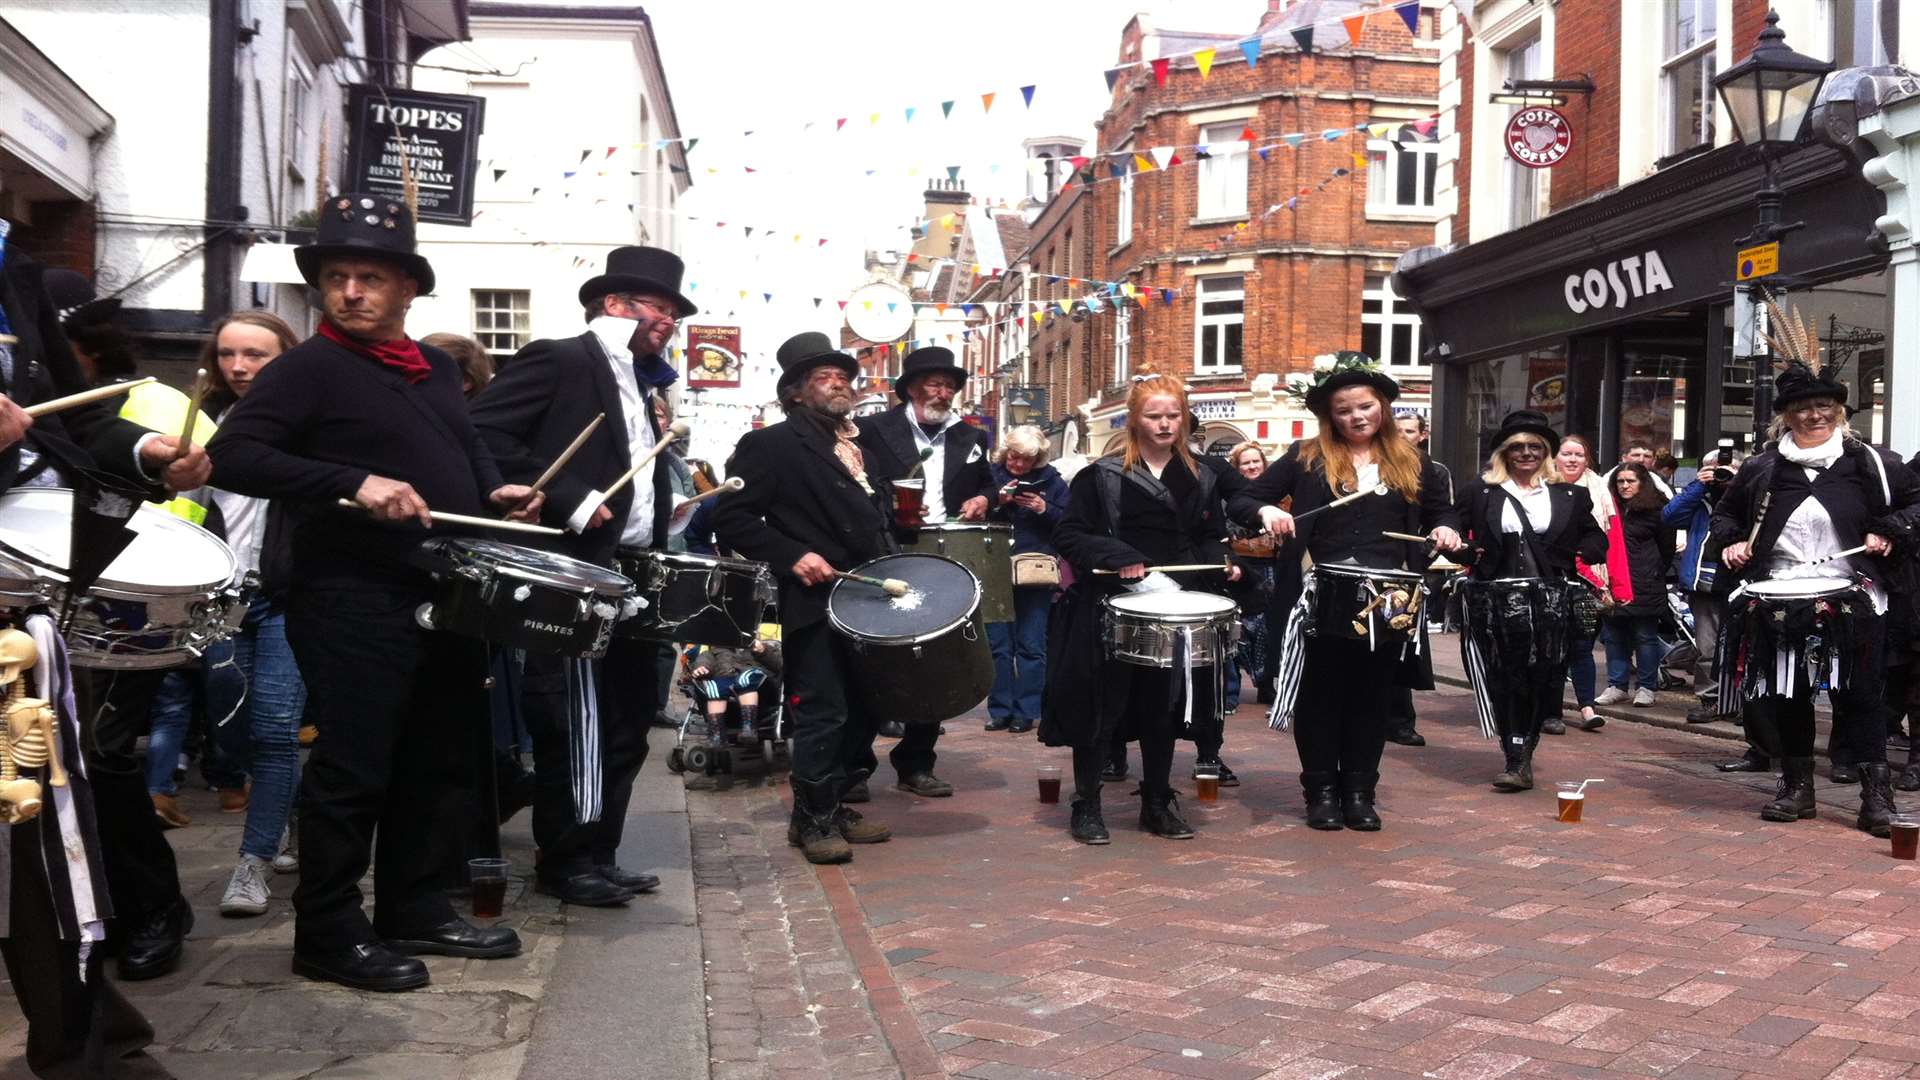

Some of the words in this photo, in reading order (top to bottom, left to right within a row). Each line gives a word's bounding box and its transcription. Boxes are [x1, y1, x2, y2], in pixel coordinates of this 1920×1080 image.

[370, 104, 463, 132] TOPES
[1517, 111, 1560, 128] COSTA
[411, 133, 419, 145] A
[384, 141, 444, 157] MODERN
[1513, 141, 1566, 163] COFFEE
[381, 154, 444, 171] BRTISH
[369, 166, 454, 183] RESTURANT
[1564, 250, 1674, 314] COSTA
[524, 619, 574, 636] PIRATES
